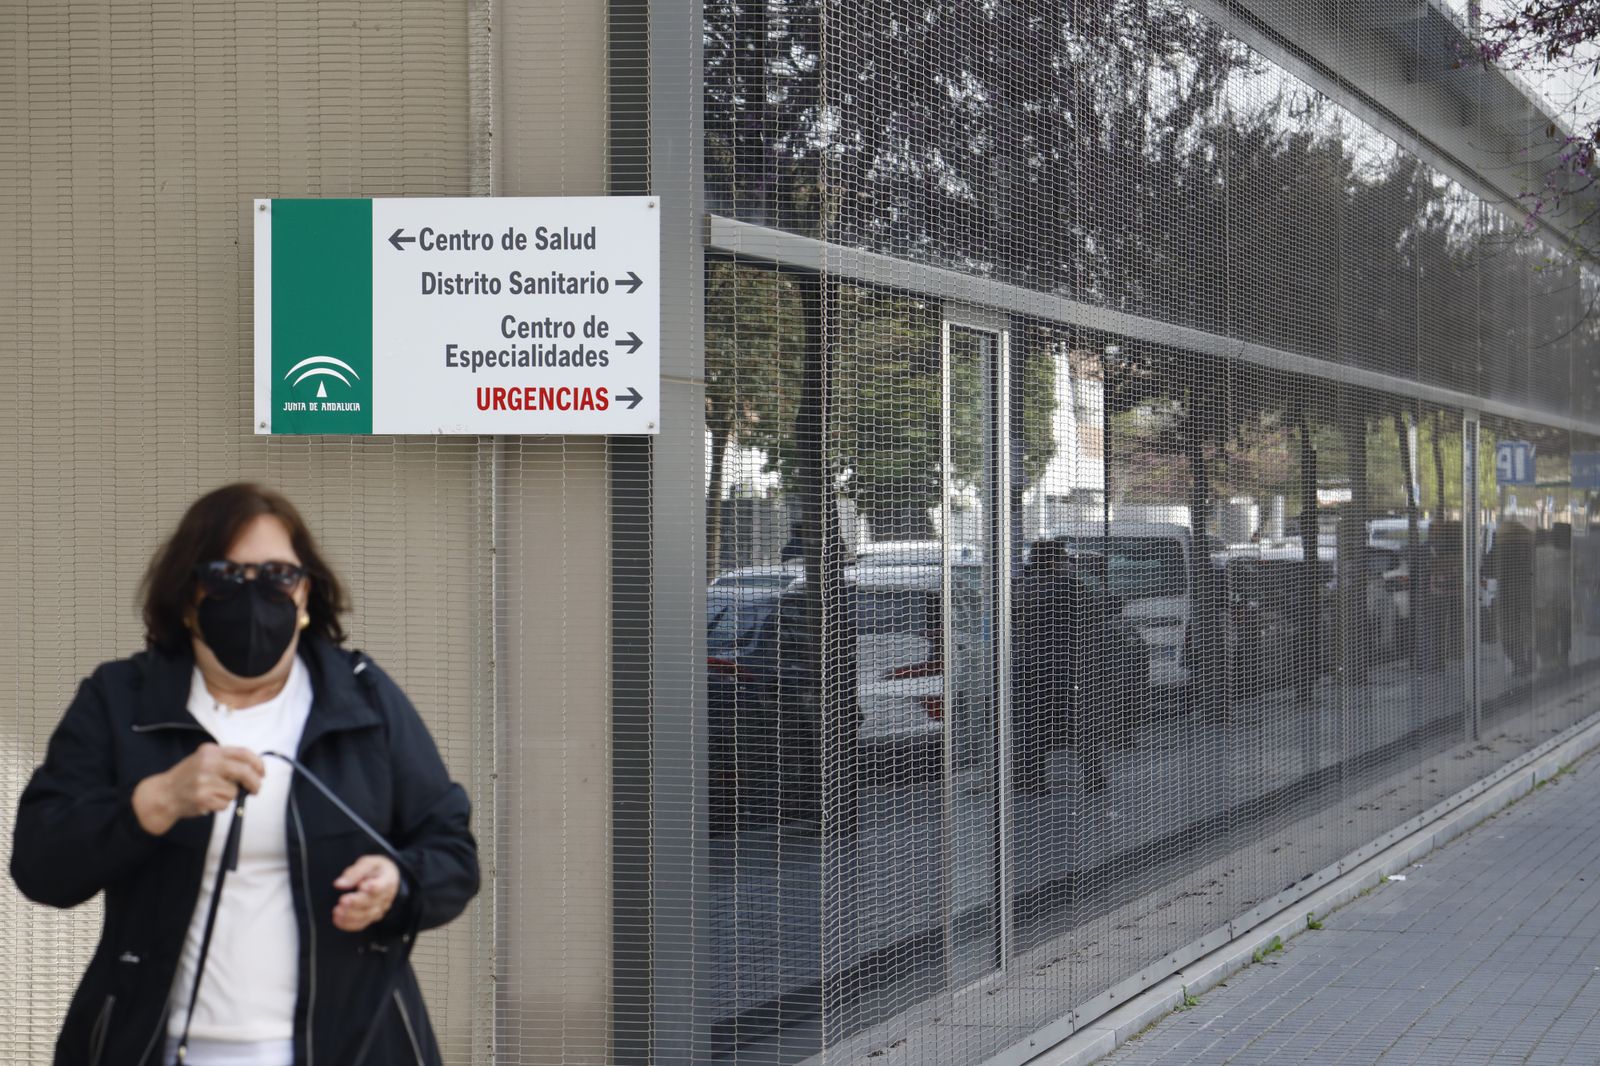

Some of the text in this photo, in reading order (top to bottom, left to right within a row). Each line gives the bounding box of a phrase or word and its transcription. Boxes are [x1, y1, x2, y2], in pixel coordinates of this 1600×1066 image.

[419, 226, 596, 252] Centro de Salud
[421, 270, 610, 296] Distrito Sanitario
[500, 314, 609, 339] Centro de
[445, 343, 610, 374] Especialidades
[283, 402, 361, 412] JUNTA DE ANDALUCIA
[476, 386, 609, 412] URGENCIAS
